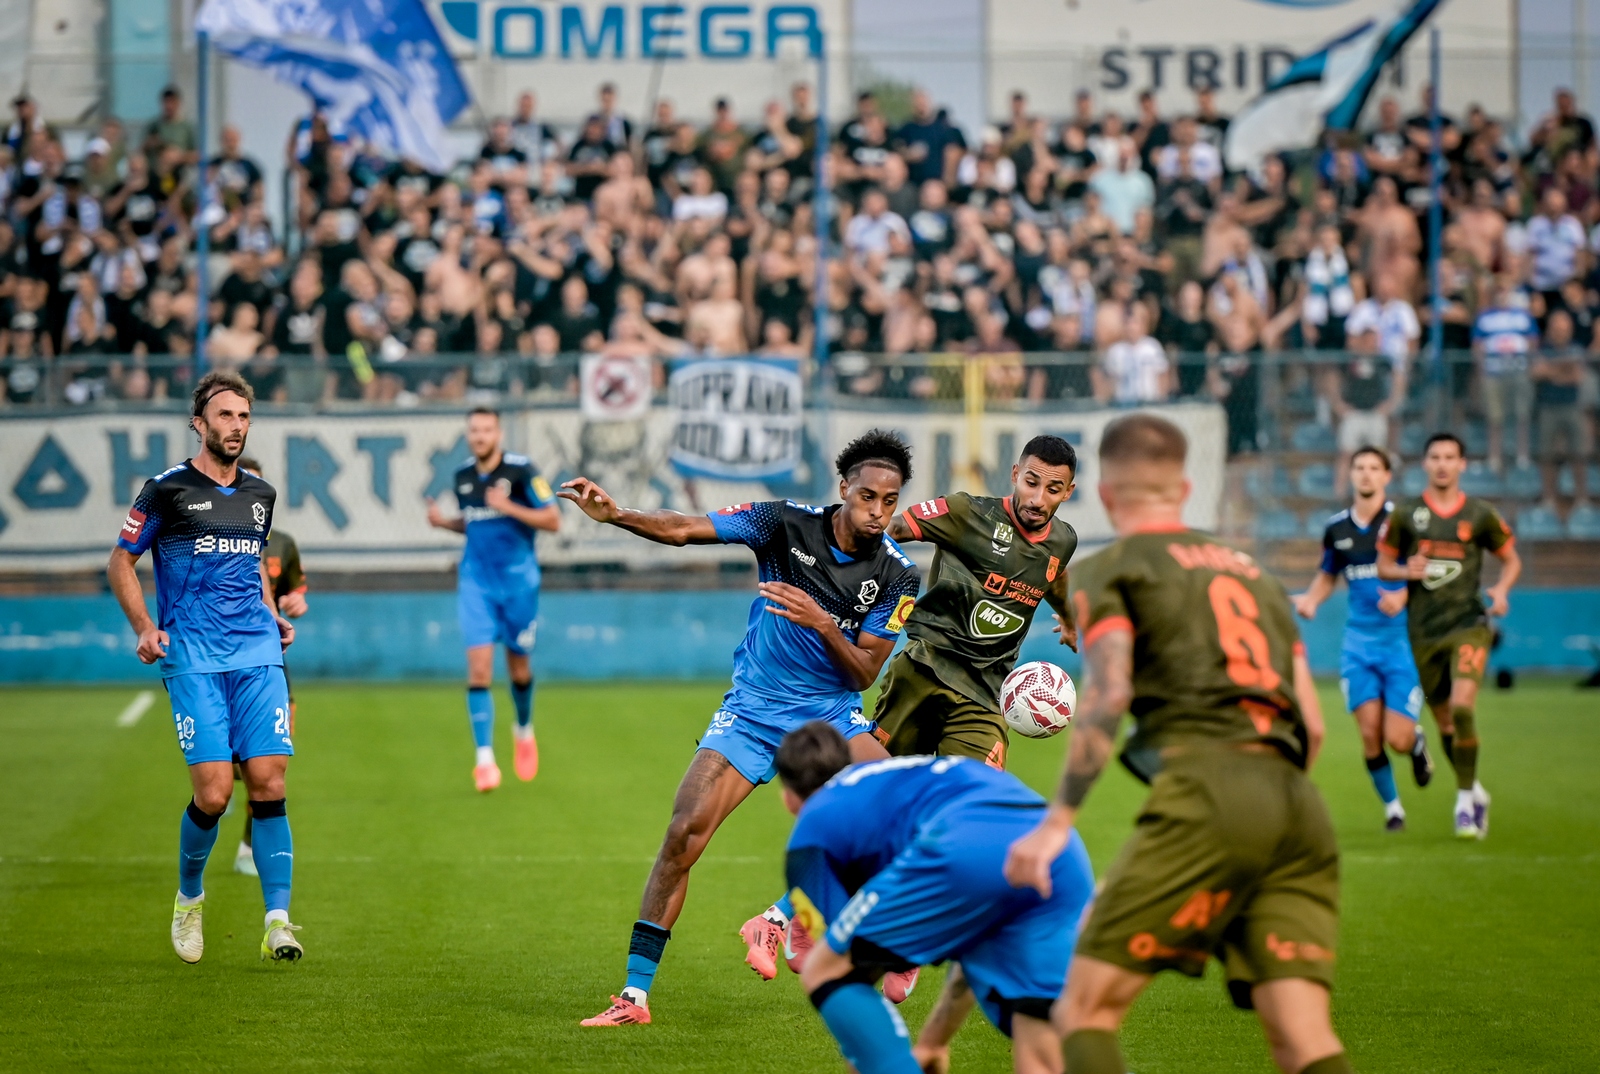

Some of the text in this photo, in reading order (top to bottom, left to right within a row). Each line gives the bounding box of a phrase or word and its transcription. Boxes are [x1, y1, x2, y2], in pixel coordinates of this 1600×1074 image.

[493, 4, 823, 59] OMEGA
[1101, 47, 1406, 90] STRID
[218, 537, 262, 555] BURA
[790, 547, 817, 567] capelli
[979, 606, 1010, 629] MOL
[1208, 574, 1280, 690] 6
